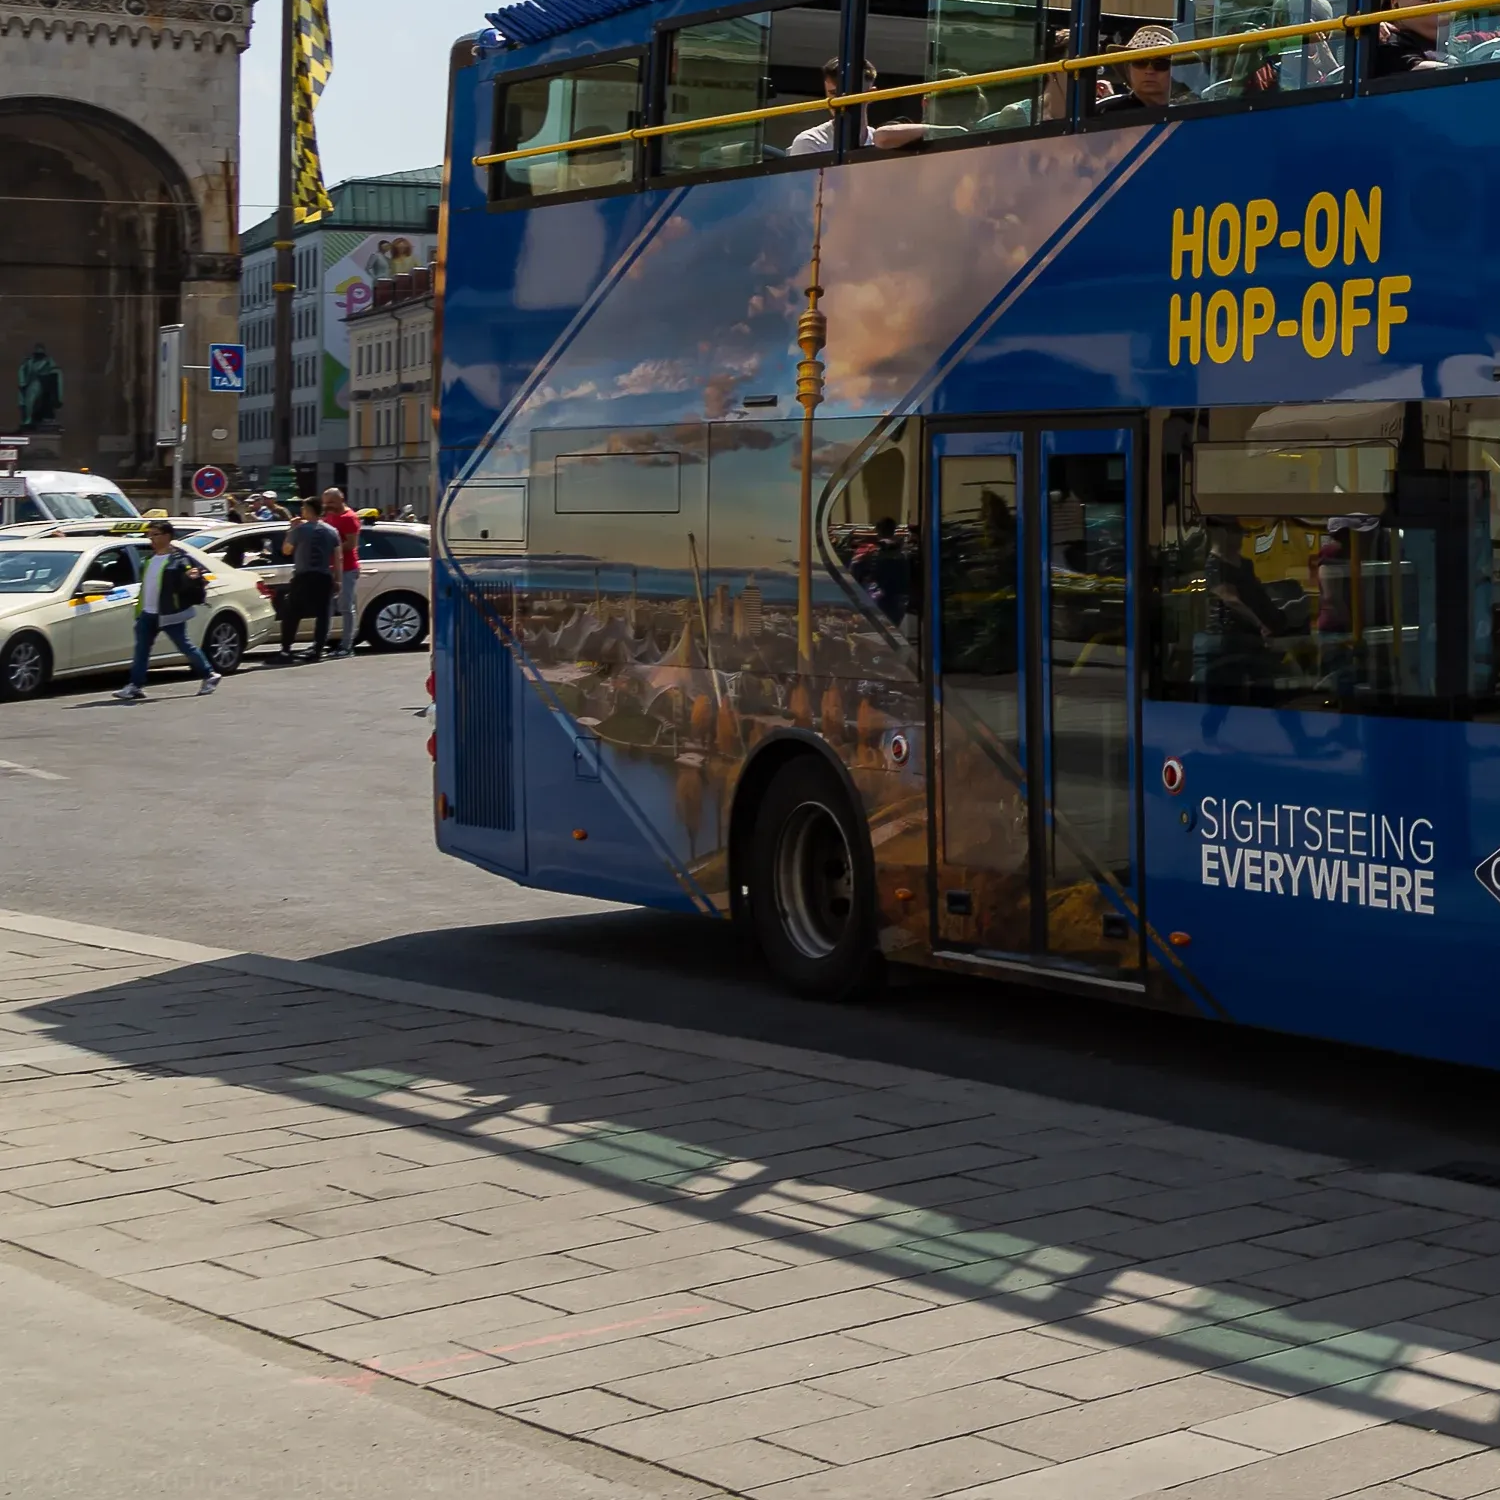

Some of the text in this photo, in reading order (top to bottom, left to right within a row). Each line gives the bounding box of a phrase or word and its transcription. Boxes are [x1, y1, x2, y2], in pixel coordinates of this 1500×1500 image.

[1170, 185, 1384, 281] HOP-ON
[1168, 274, 1412, 367] HOP-OFF
[1200, 794, 1436, 865] SIGHTSEEING
[1200, 844, 1437, 916] EVERYWHERE
